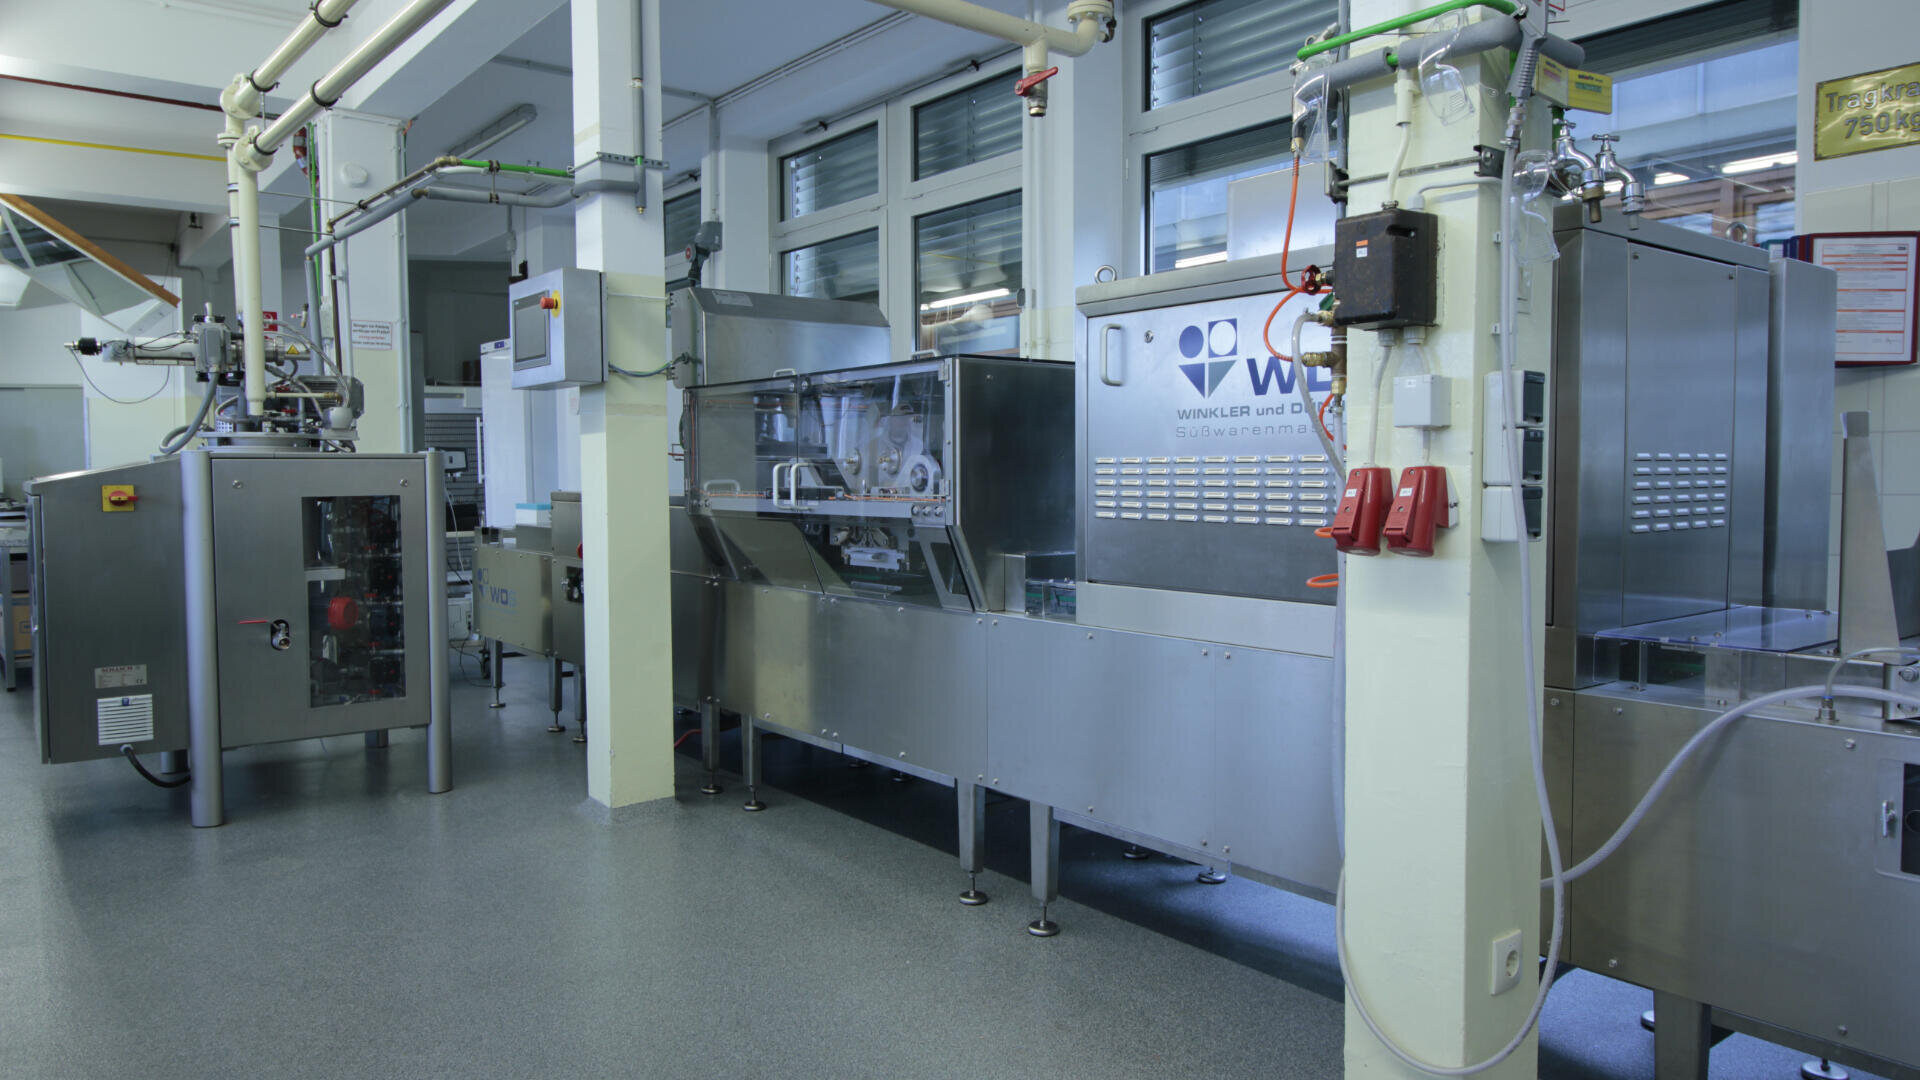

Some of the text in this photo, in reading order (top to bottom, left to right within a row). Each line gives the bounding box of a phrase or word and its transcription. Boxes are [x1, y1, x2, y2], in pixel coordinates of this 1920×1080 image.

[1844, 113, 1889, 139] 750
[1177, 406, 1250, 420] WINKLER
[1256, 403, 1284, 416] und
